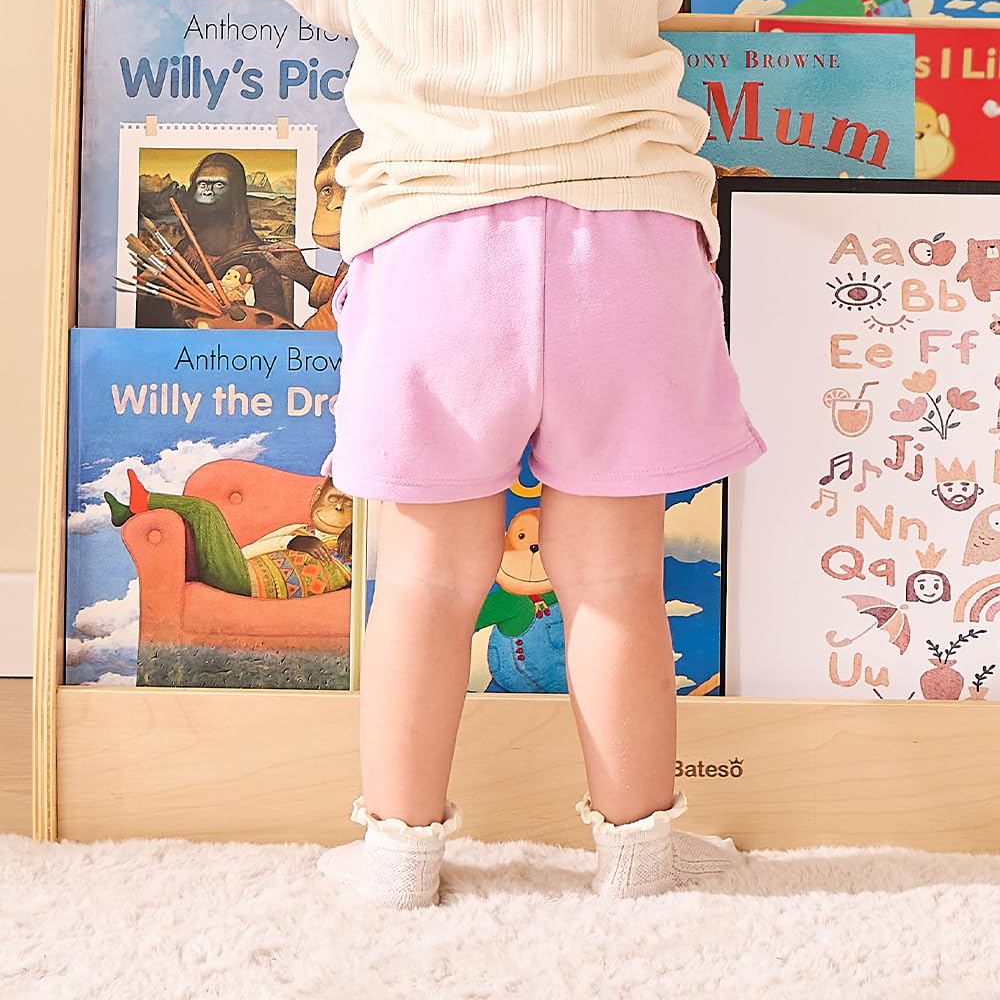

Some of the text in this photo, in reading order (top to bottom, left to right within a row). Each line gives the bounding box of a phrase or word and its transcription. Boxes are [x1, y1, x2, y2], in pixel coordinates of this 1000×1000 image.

[183, 13, 288, 50] Anthony
[744, 49, 841, 69] BROWNE
[940, 47, 952, 80] I
[280, 57, 350, 101] Pic
[702, 80, 891, 170] Mum
[829, 232, 905, 266] Aa
[901, 278, 967, 313] Bb
[173, 344, 277, 379] Anthony
[830, 334, 894, 369] Ee
[919, 329, 980, 365] Ff
[110, 383, 202, 424] Willy
[212, 383, 272, 417] the
[884, 434, 925, 482] Jj
[856, 504, 928, 543] Nn
[820, 544, 896, 587] Qq
[828, 652, 890, 688] Uu
[675, 758, 744, 778] Bateso
